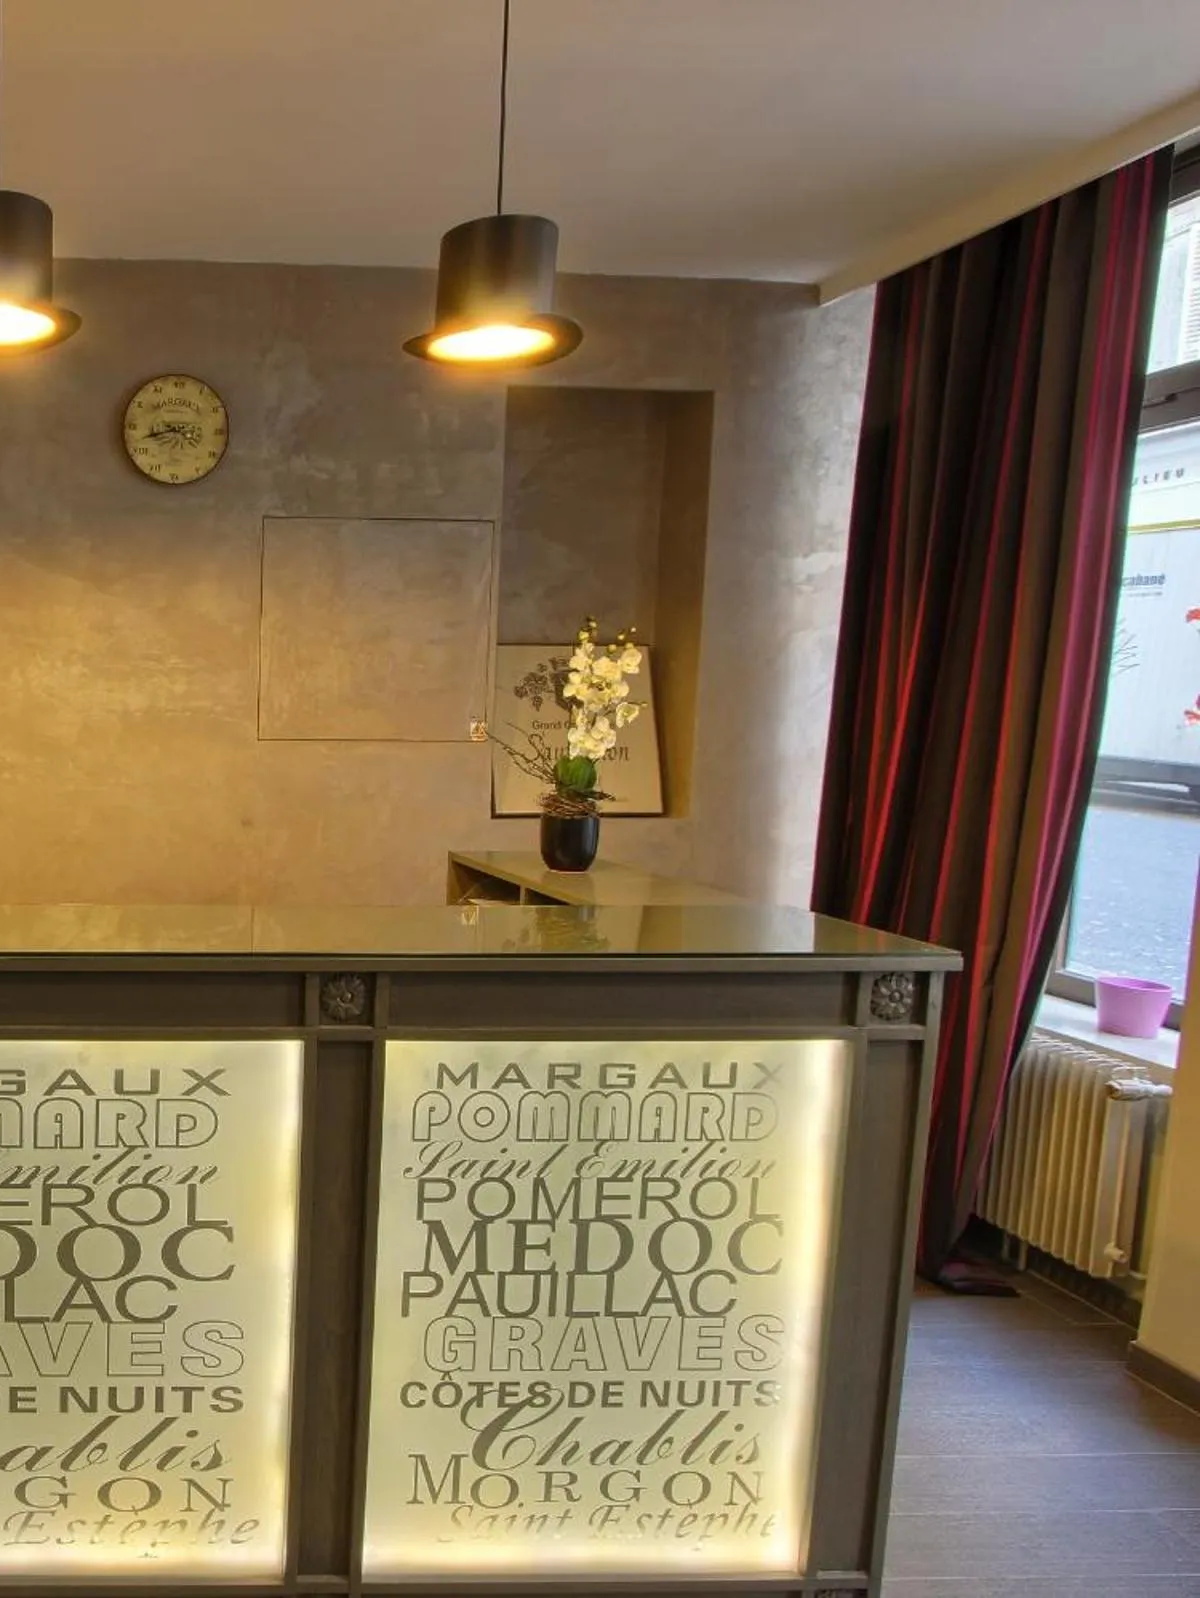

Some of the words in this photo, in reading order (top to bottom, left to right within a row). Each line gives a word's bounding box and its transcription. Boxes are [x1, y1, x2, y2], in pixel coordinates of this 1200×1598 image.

[436, 1062, 784, 1090] MARGAUX
[411, 1089, 779, 1143] POMMARD
[402, 1140, 568, 1180] Saint
[575, 1140, 777, 1181] Emilion
[415, 1176, 781, 1222] POMEROL
[422, 1218, 784, 1276] MEDOC
[401, 1269, 737, 1318] PAUILLAC
[423, 1314, 785, 1373] GRAVES
[59, 1385, 244, 1413] NUITS
[567, 1379, 625, 1408] DE
[639, 1379, 781, 1408] NUITS
[460, 1387, 761, 1472] Chablis
[406, 1453, 765, 1509] MORGON
[436, 1500, 574, 1543] Saint
